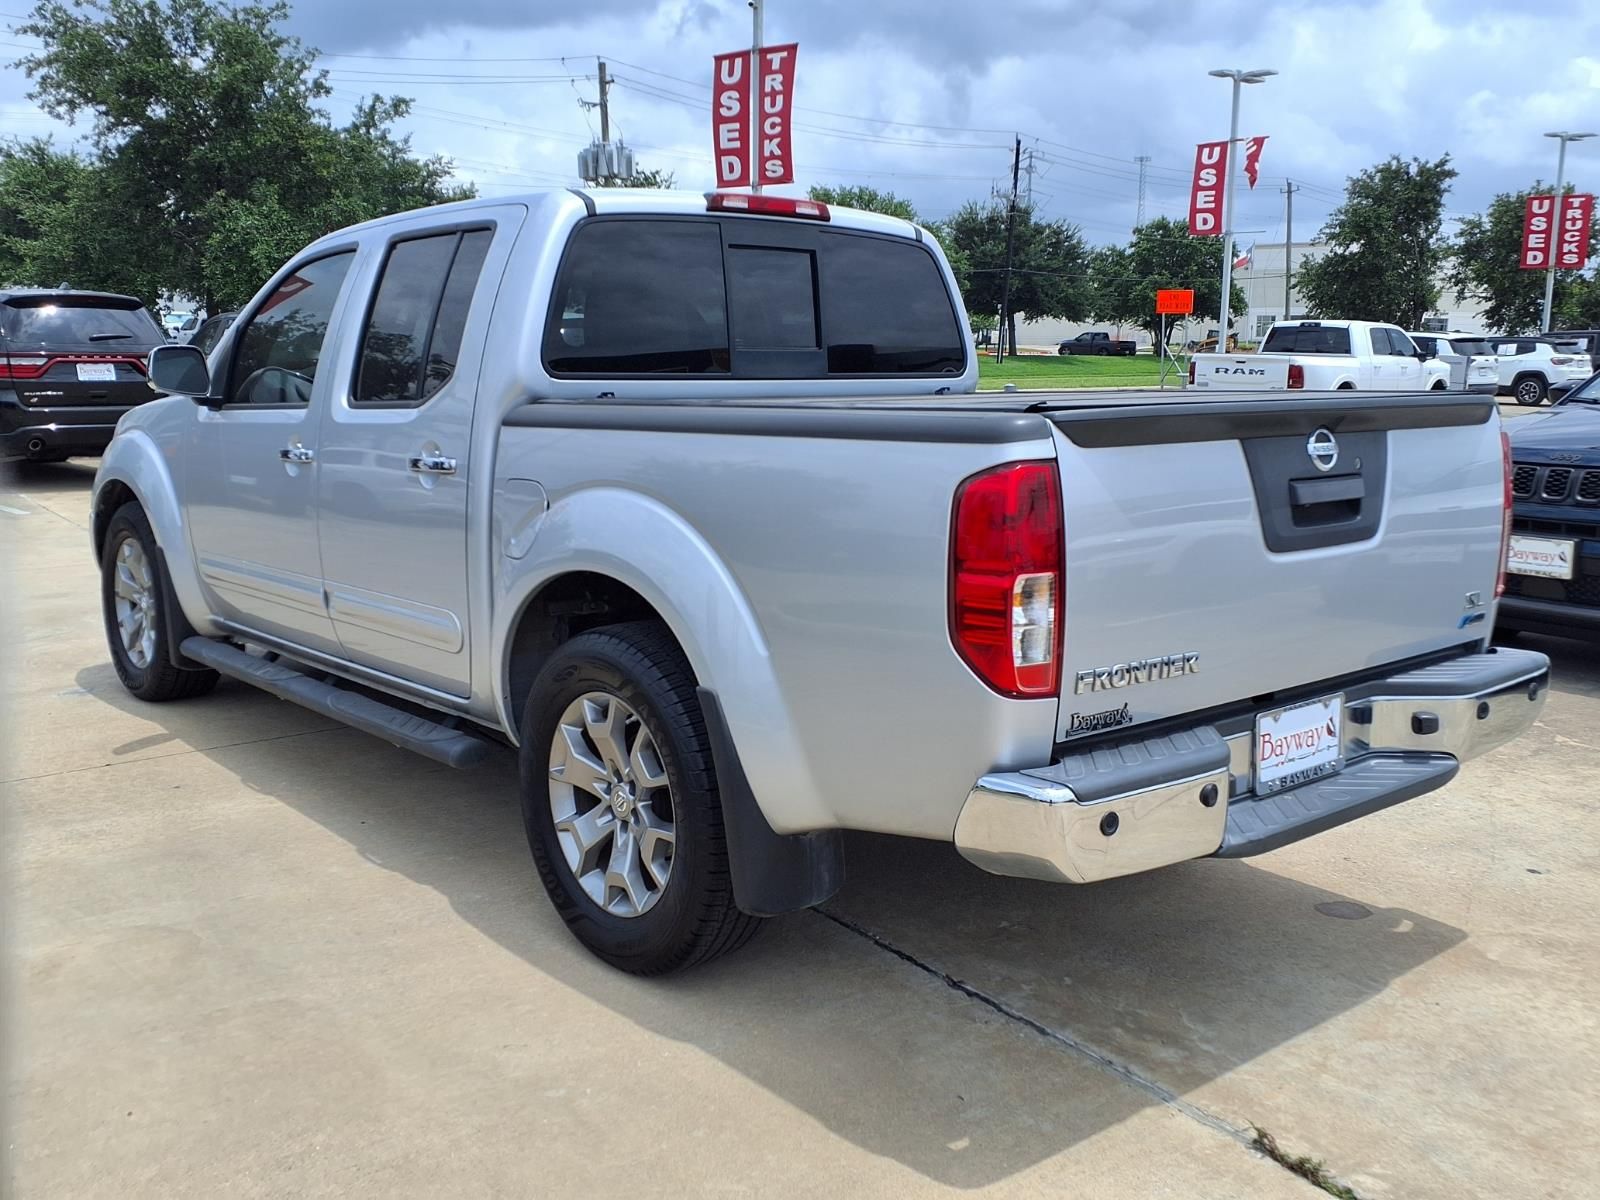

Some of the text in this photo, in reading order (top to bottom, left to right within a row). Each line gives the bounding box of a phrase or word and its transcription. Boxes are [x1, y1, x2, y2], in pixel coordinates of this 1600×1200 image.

[719, 57, 743, 181] USED
[763, 52, 788, 178] TRUCKS
[1195, 146, 1220, 231] USED
[1526, 199, 1550, 265] USED
[1562, 197, 1586, 264] TRUCKS
[1214, 367, 1265, 376] RAM
[1550, 452, 1584, 465] Jeep
[1074, 651, 1200, 695] FRONTIER
[1070, 707, 1124, 732] Bayway
[1260, 726, 1324, 762] Bayway
[1280, 765, 1325, 788] BAYWAY
